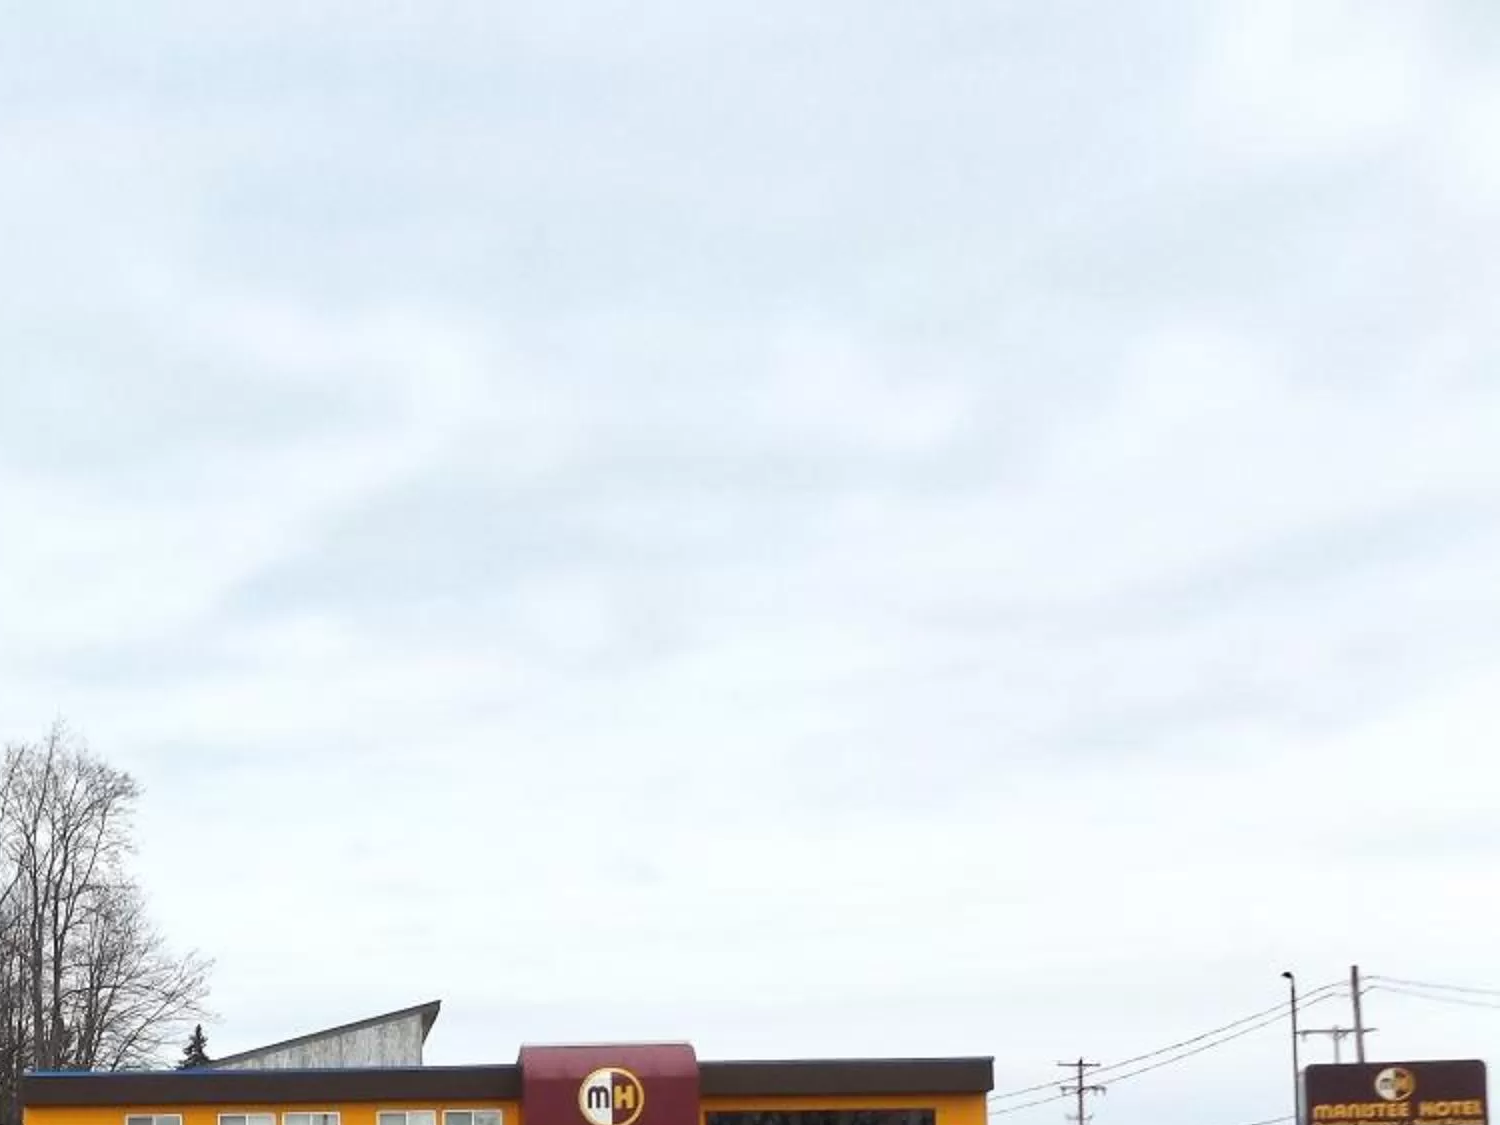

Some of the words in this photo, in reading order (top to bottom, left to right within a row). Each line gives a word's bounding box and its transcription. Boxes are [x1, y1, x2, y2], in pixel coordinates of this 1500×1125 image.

[587, 1085, 635, 1109] MH
[1313, 1101, 1409, 1119] MANISTEE
[1418, 1099, 1482, 1116] HOTEL
